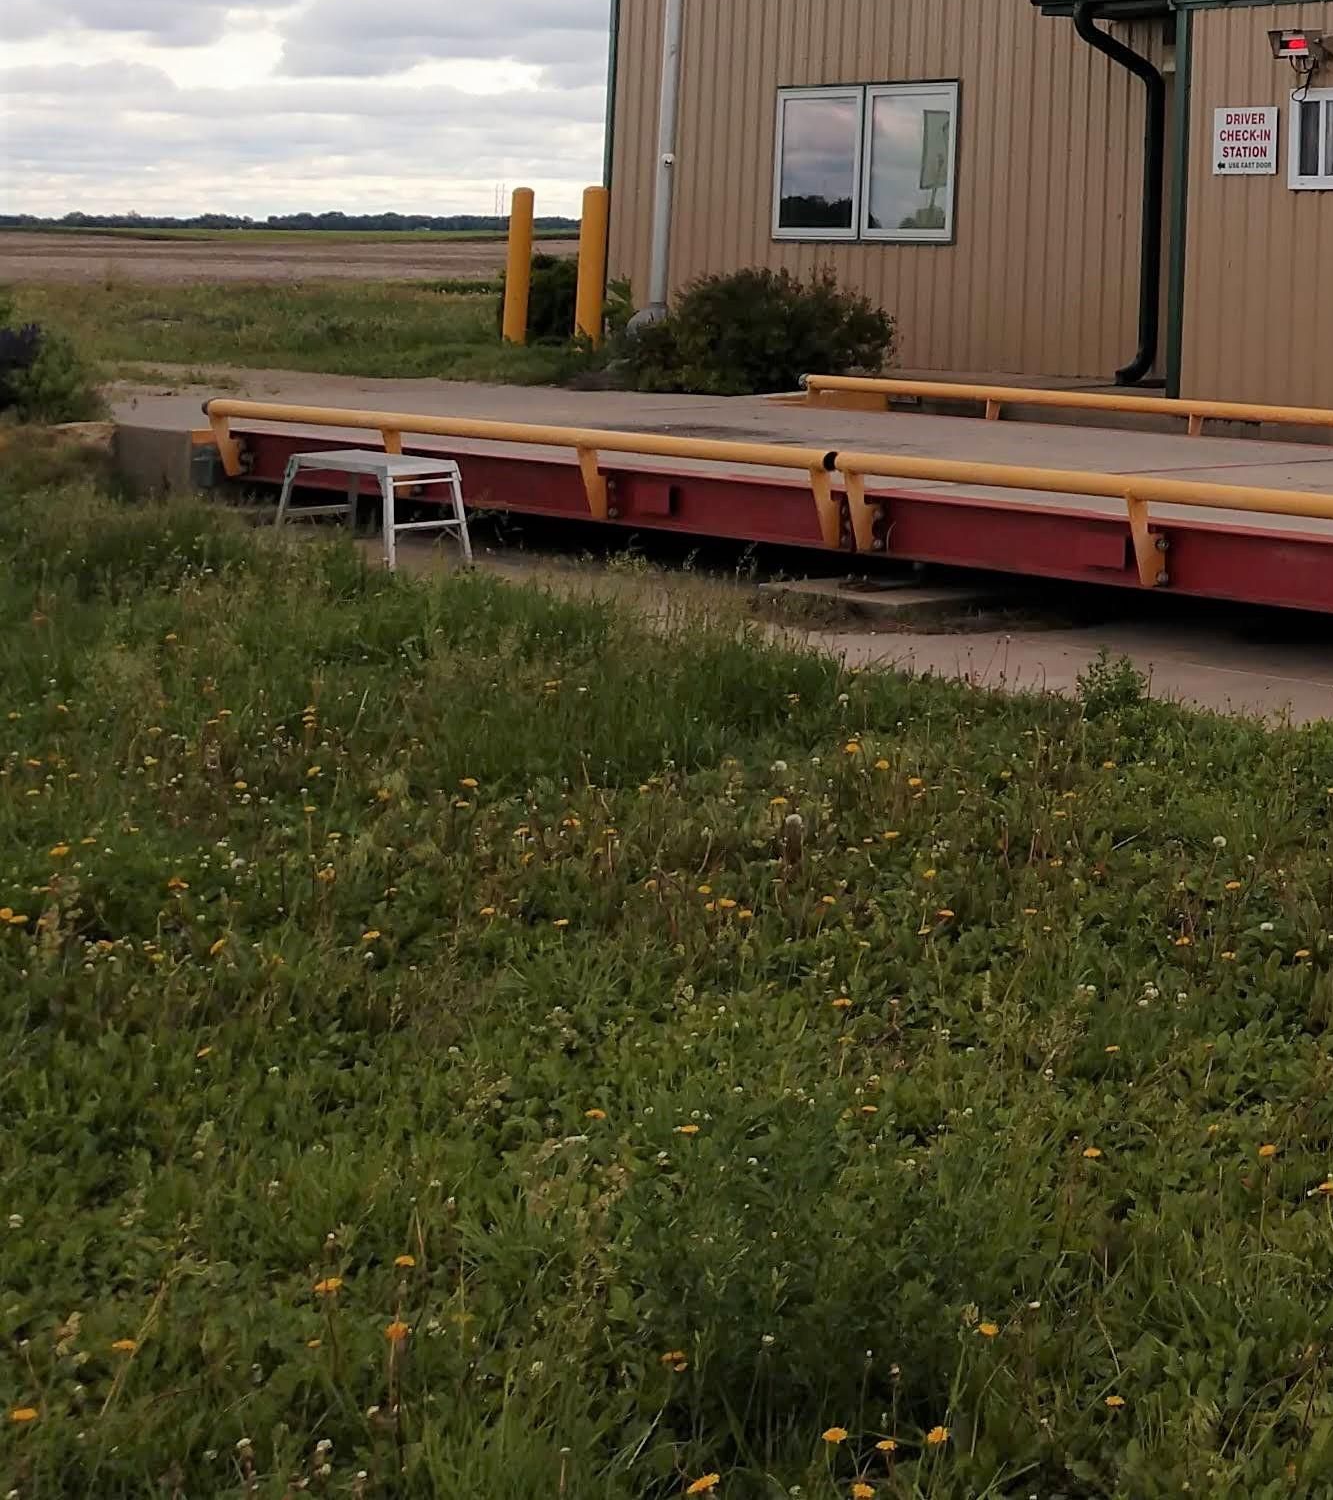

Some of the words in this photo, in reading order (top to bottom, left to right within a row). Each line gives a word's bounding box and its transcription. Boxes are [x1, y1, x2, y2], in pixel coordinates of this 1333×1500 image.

[1226, 113, 1265, 125] DRIVER
[1219, 129, 1271, 141] CHECK-IN
[1222, 145, 1267, 158] STATION
